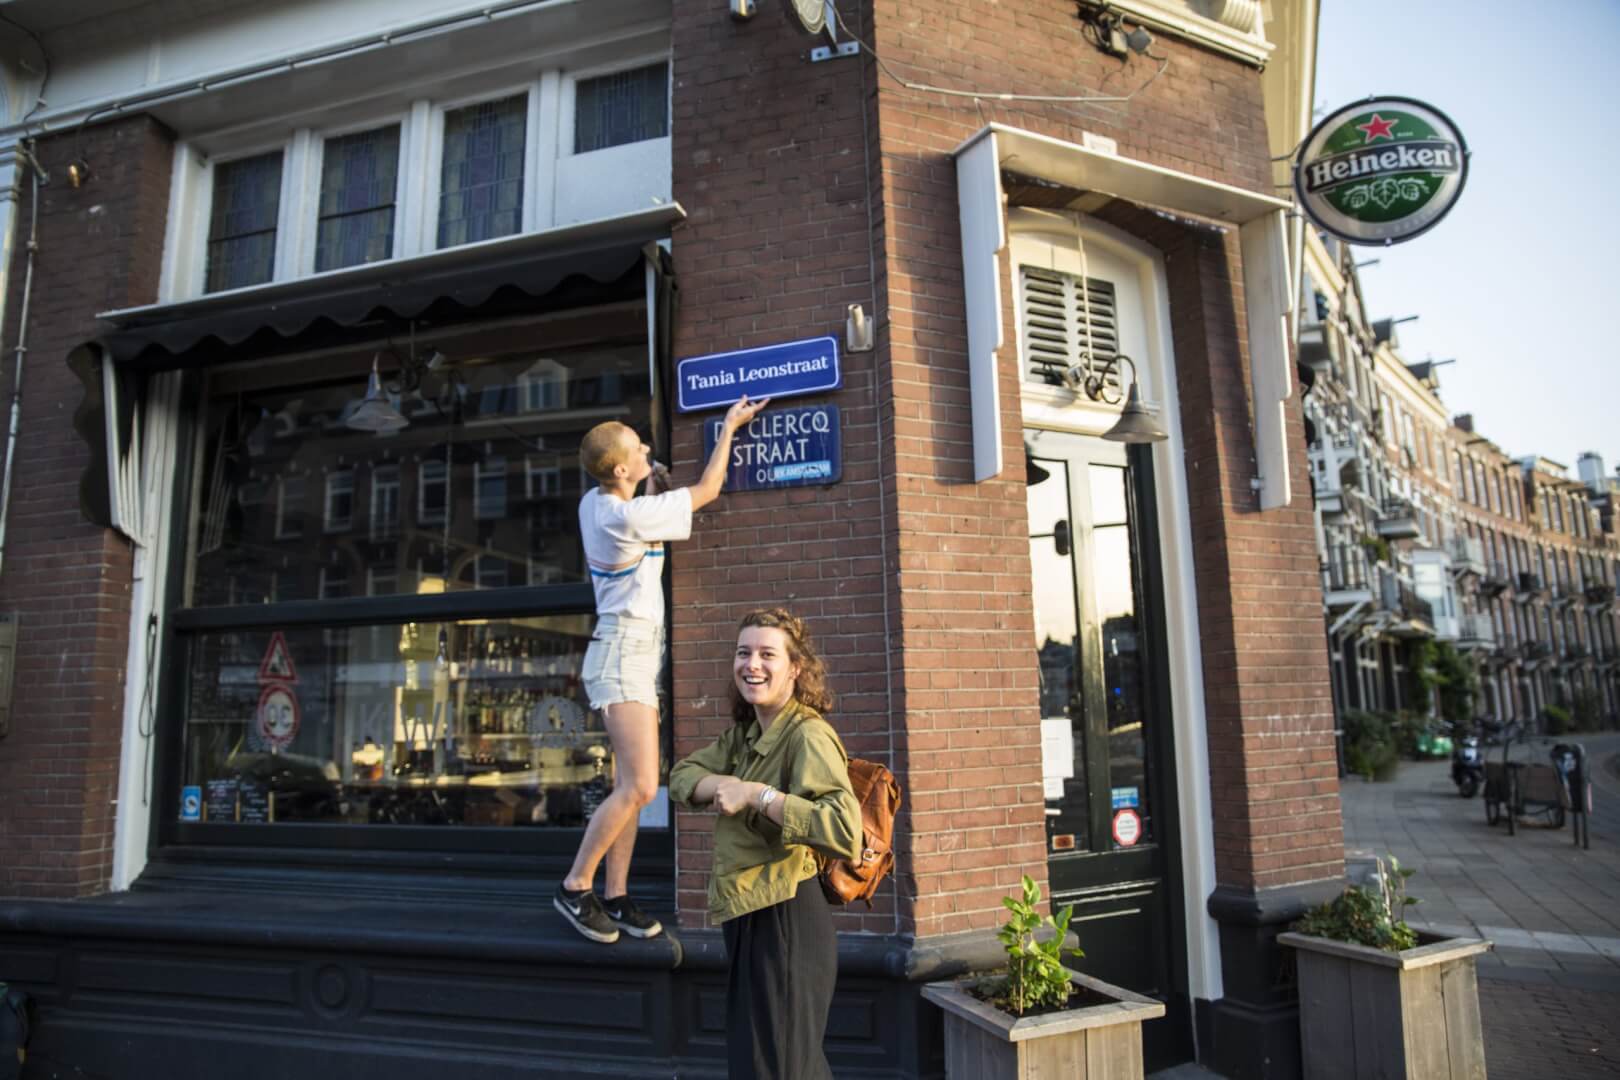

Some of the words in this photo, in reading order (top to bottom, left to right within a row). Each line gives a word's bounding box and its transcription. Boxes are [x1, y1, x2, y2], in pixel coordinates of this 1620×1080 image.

[1311, 145, 1453, 186] Heineken
[687, 370, 736, 391] Tania
[739, 355, 829, 383] Leonstraat
[748, 411, 830, 439] CLERCQ
[733, 439, 809, 467] STRAAT
